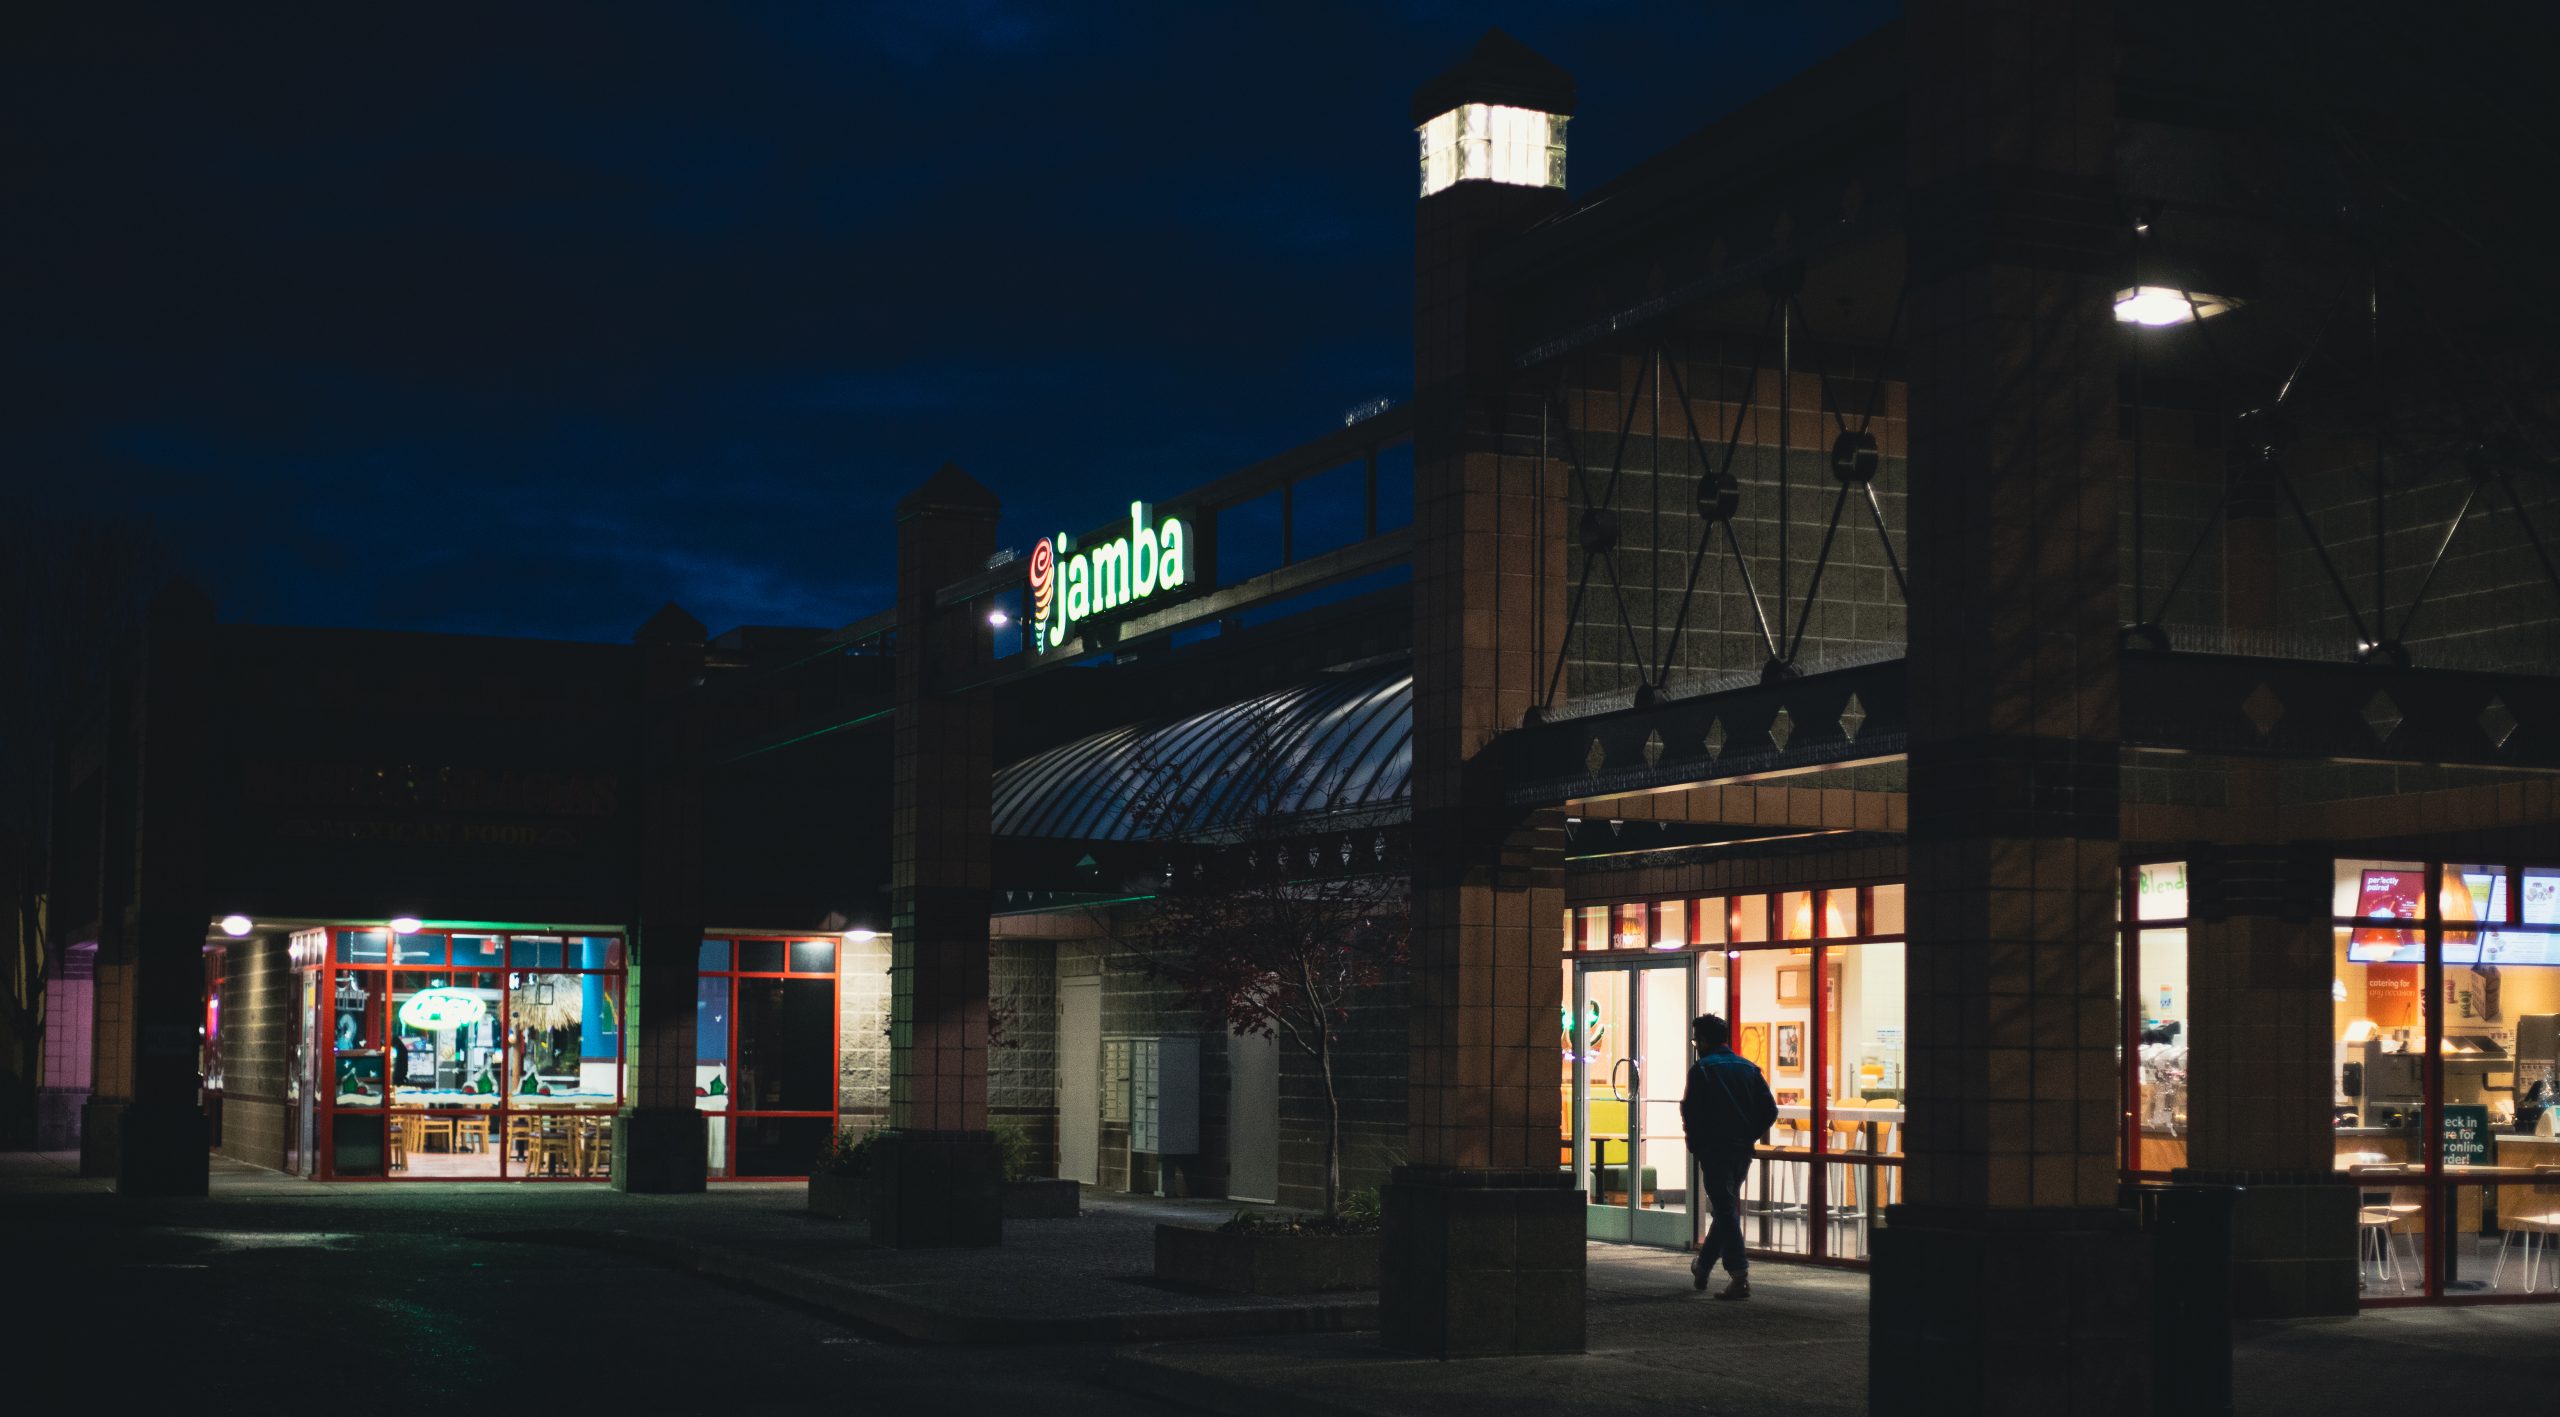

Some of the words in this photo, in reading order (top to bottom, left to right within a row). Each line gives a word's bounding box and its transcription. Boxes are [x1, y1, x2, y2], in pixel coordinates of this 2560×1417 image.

[1050, 500, 1184, 647] jamba
[322, 819, 452, 843] MEXICAN
[464, 825, 537, 845] FOOD
[2367, 876, 2399, 887] perfectly
[2366, 884, 2390, 893] paired
[2369, 979, 2399, 990] catering
[2400, 979, 2411, 988] for
[2444, 1116, 2465, 1127] eck
[2467, 1116, 2478, 1128] in
[2459, 1129, 2476, 1140] for
[2449, 1142, 2485, 1153] online
[2443, 1153, 2470, 1165] rder!
